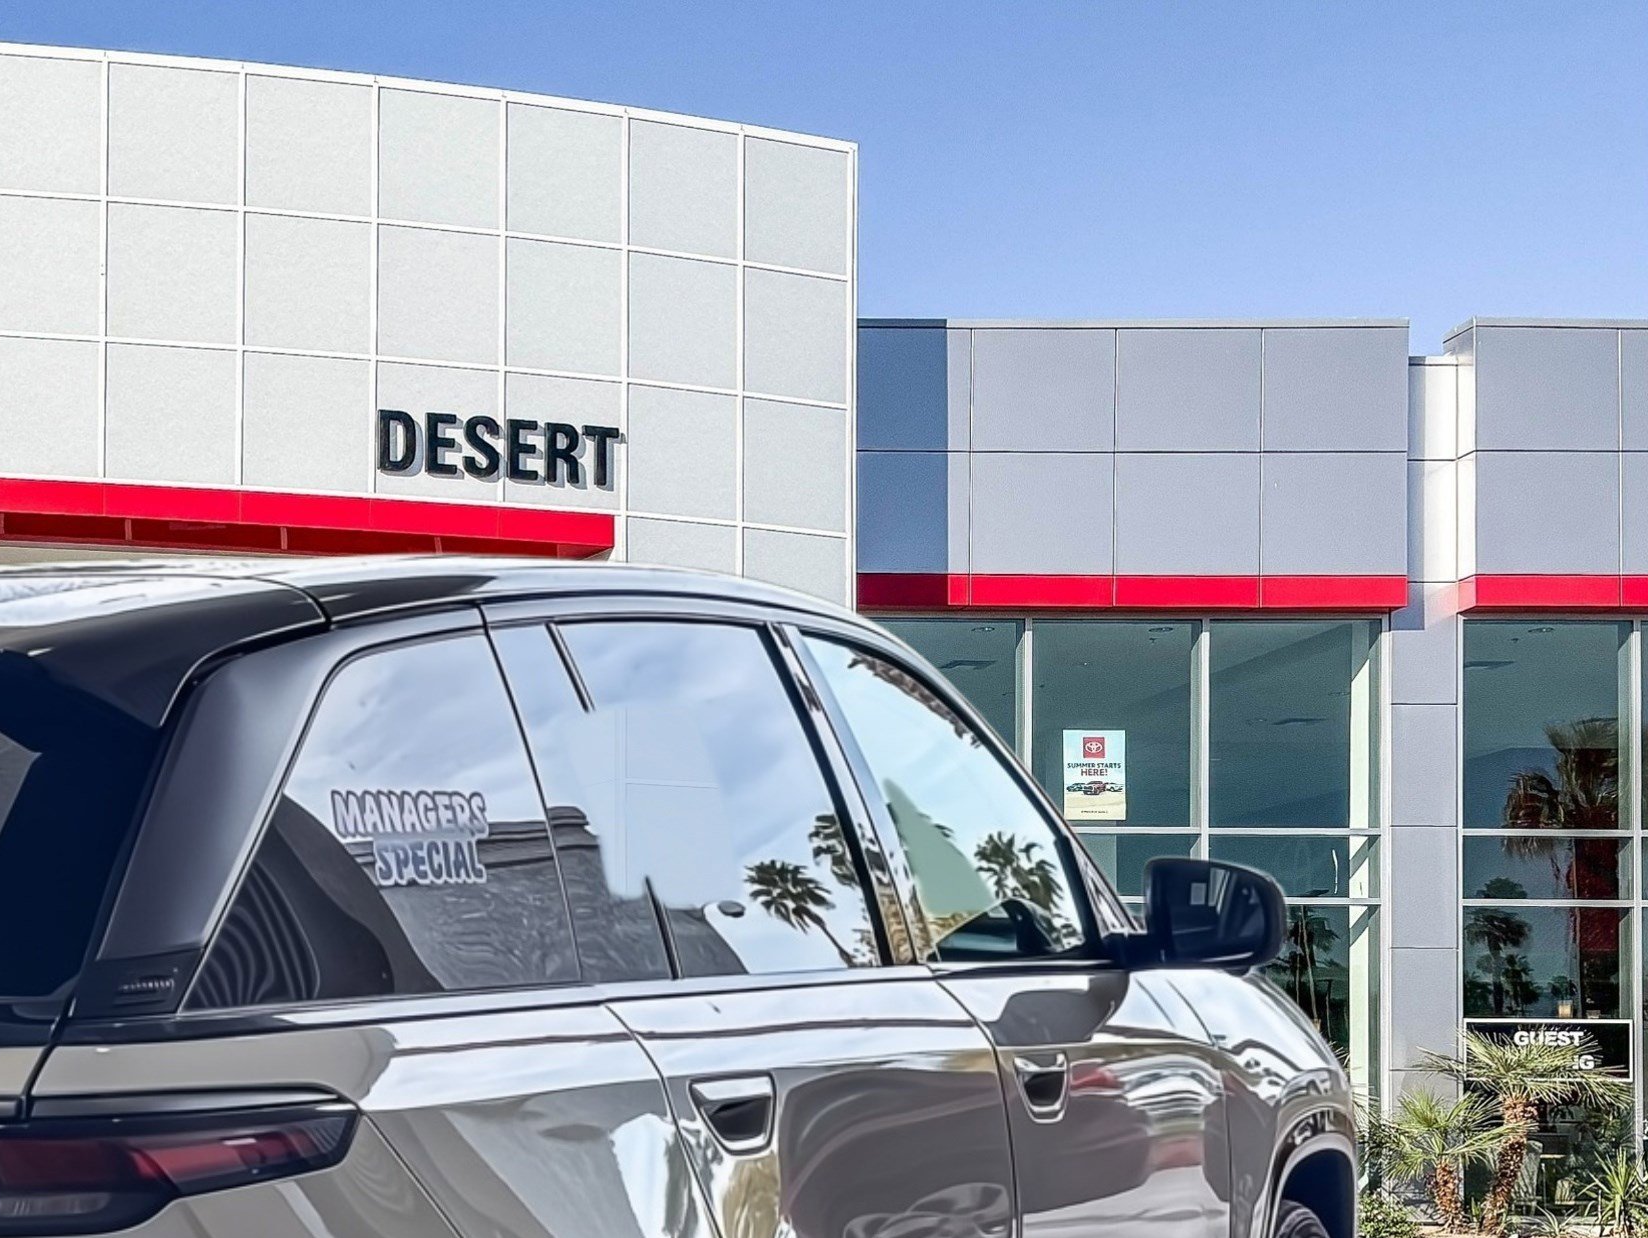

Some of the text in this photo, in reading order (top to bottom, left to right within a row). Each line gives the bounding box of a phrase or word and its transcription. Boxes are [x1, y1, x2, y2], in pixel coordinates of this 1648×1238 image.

[377, 409, 620, 486] DESERT
[331, 789, 488, 838] MANAGERS
[376, 840, 486, 882] SPECIAL
[1513, 1030, 1584, 1047] GUEST
